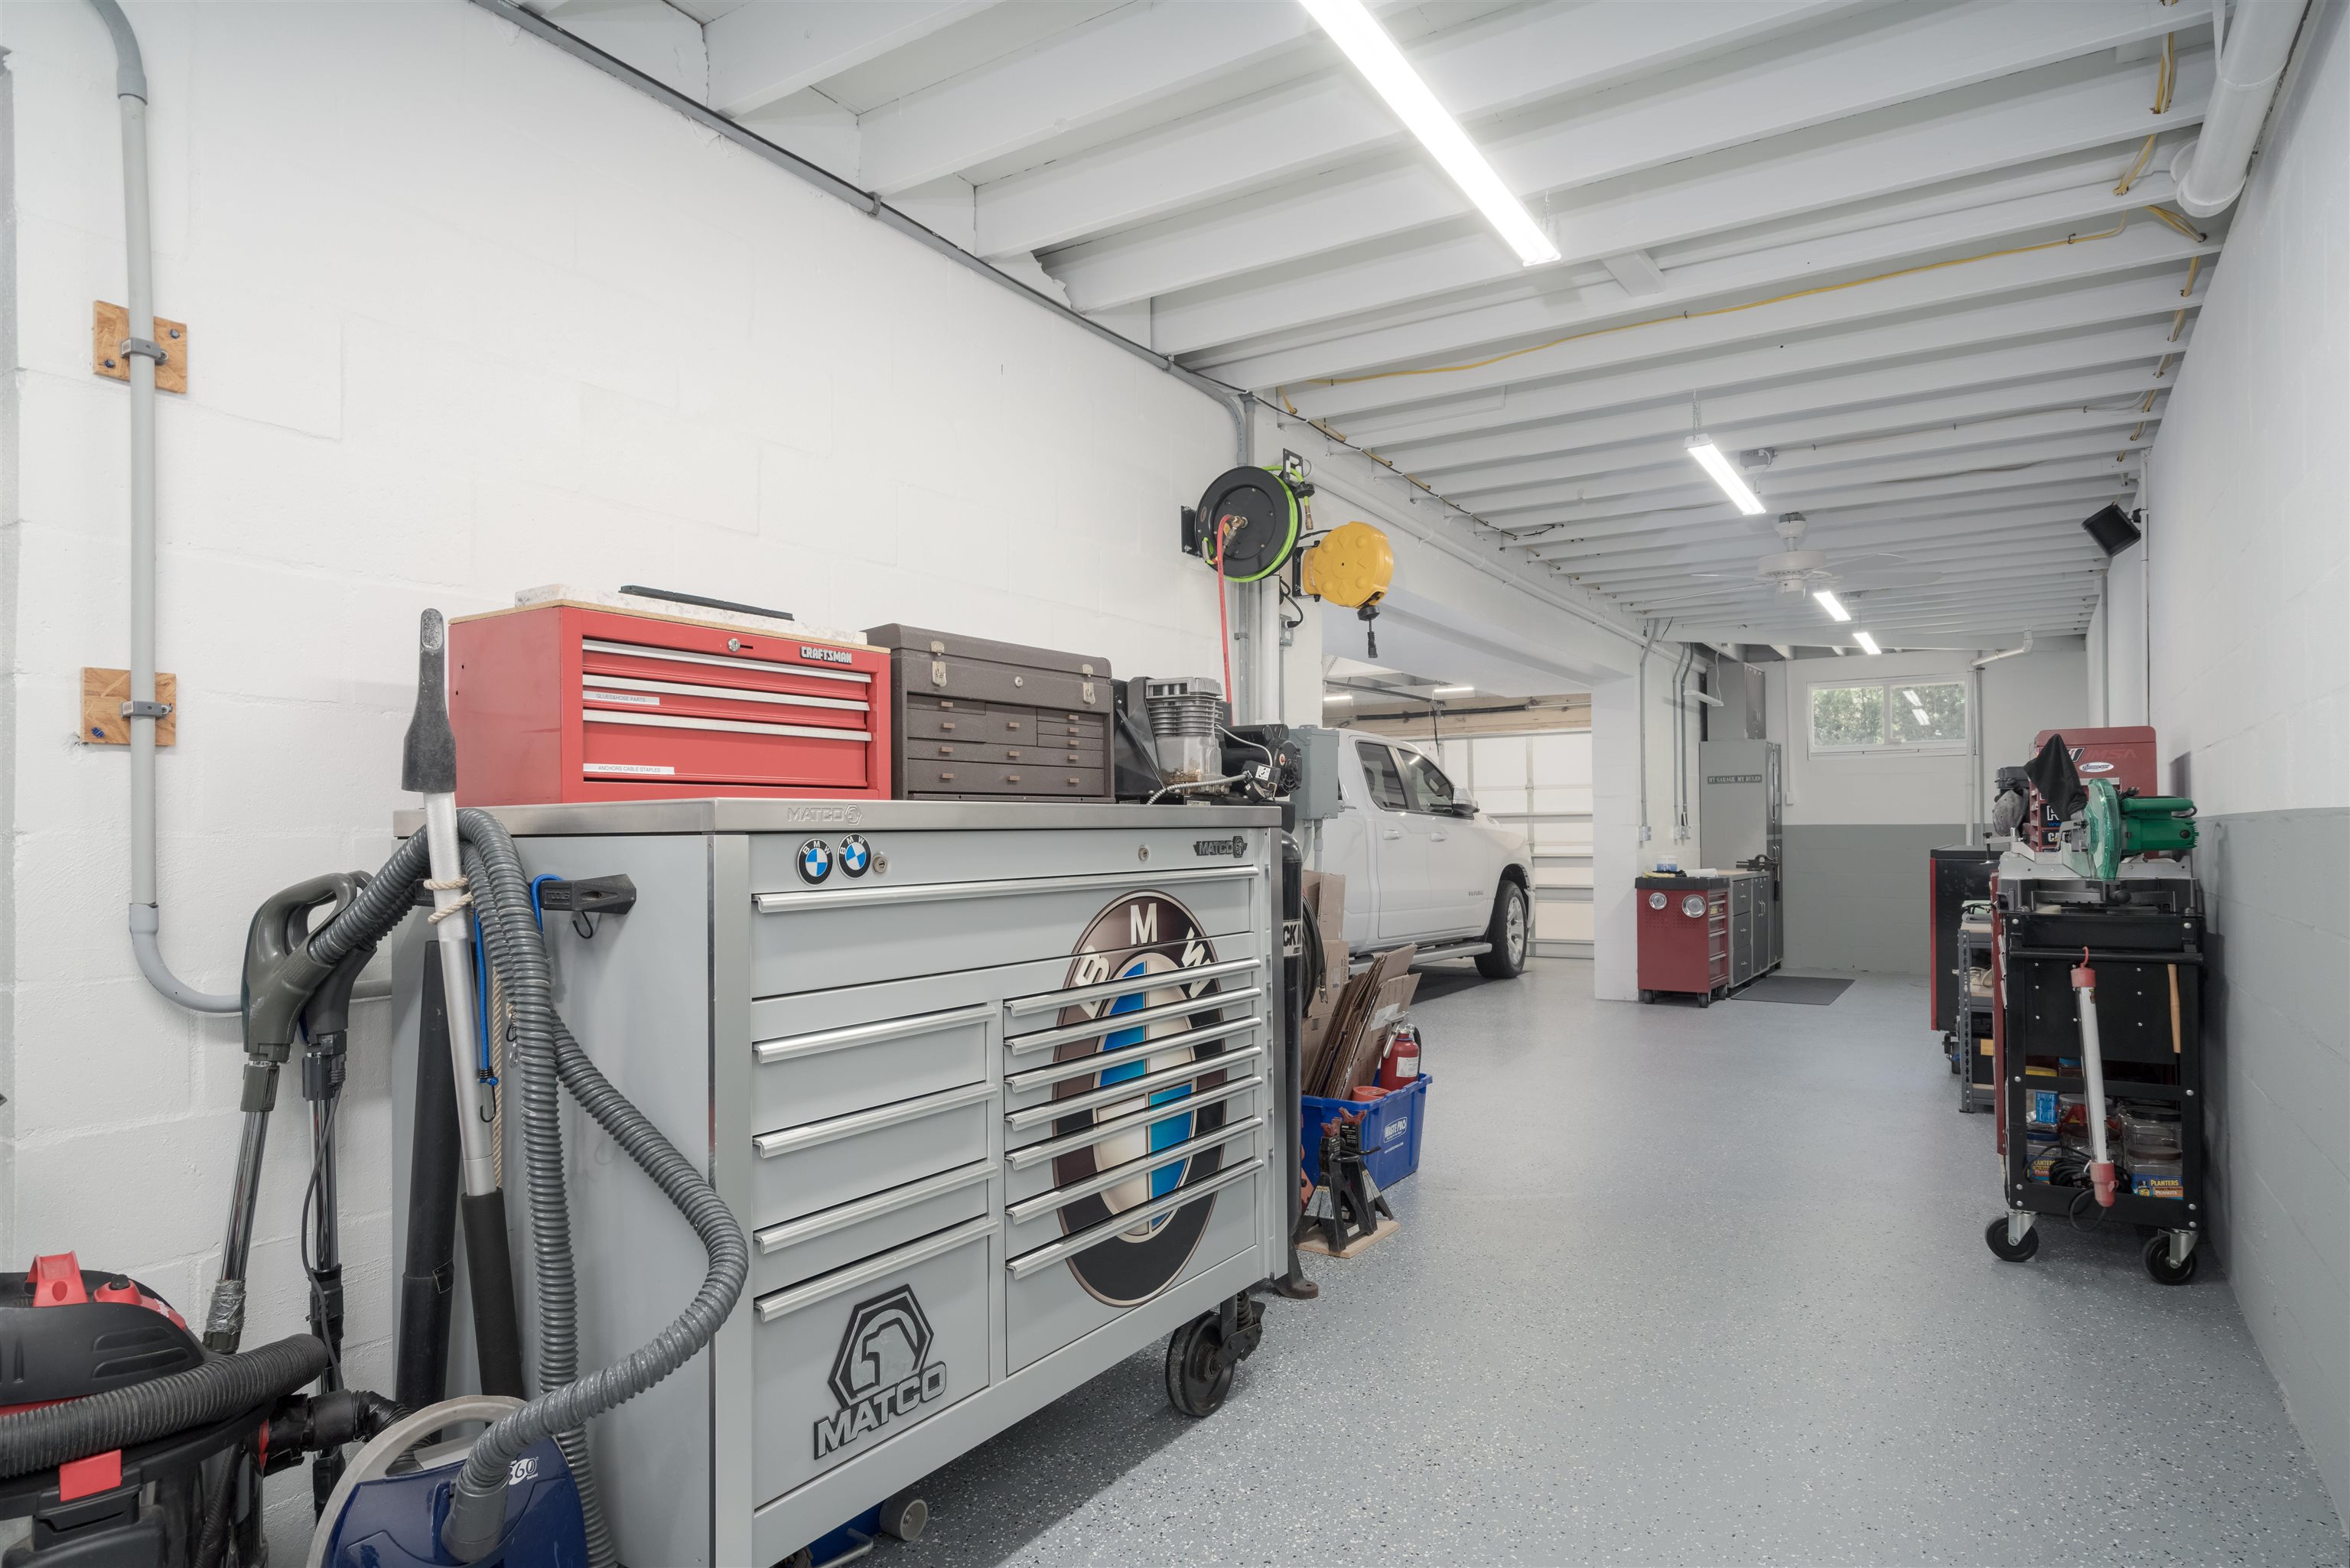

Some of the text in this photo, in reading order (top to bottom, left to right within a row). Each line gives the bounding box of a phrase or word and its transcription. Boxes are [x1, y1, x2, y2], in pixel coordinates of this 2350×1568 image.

[800, 646, 852, 665] CRAFTSMAN
[596, 693, 629, 701] GLUES&HOSE
[787, 807, 845, 821] MATCO
[802, 841, 831, 855] BMW
[839, 836, 865, 855] BMW
[1199, 841, 1234, 855] MATCO
[814, 1360, 947, 1460] MATCO
